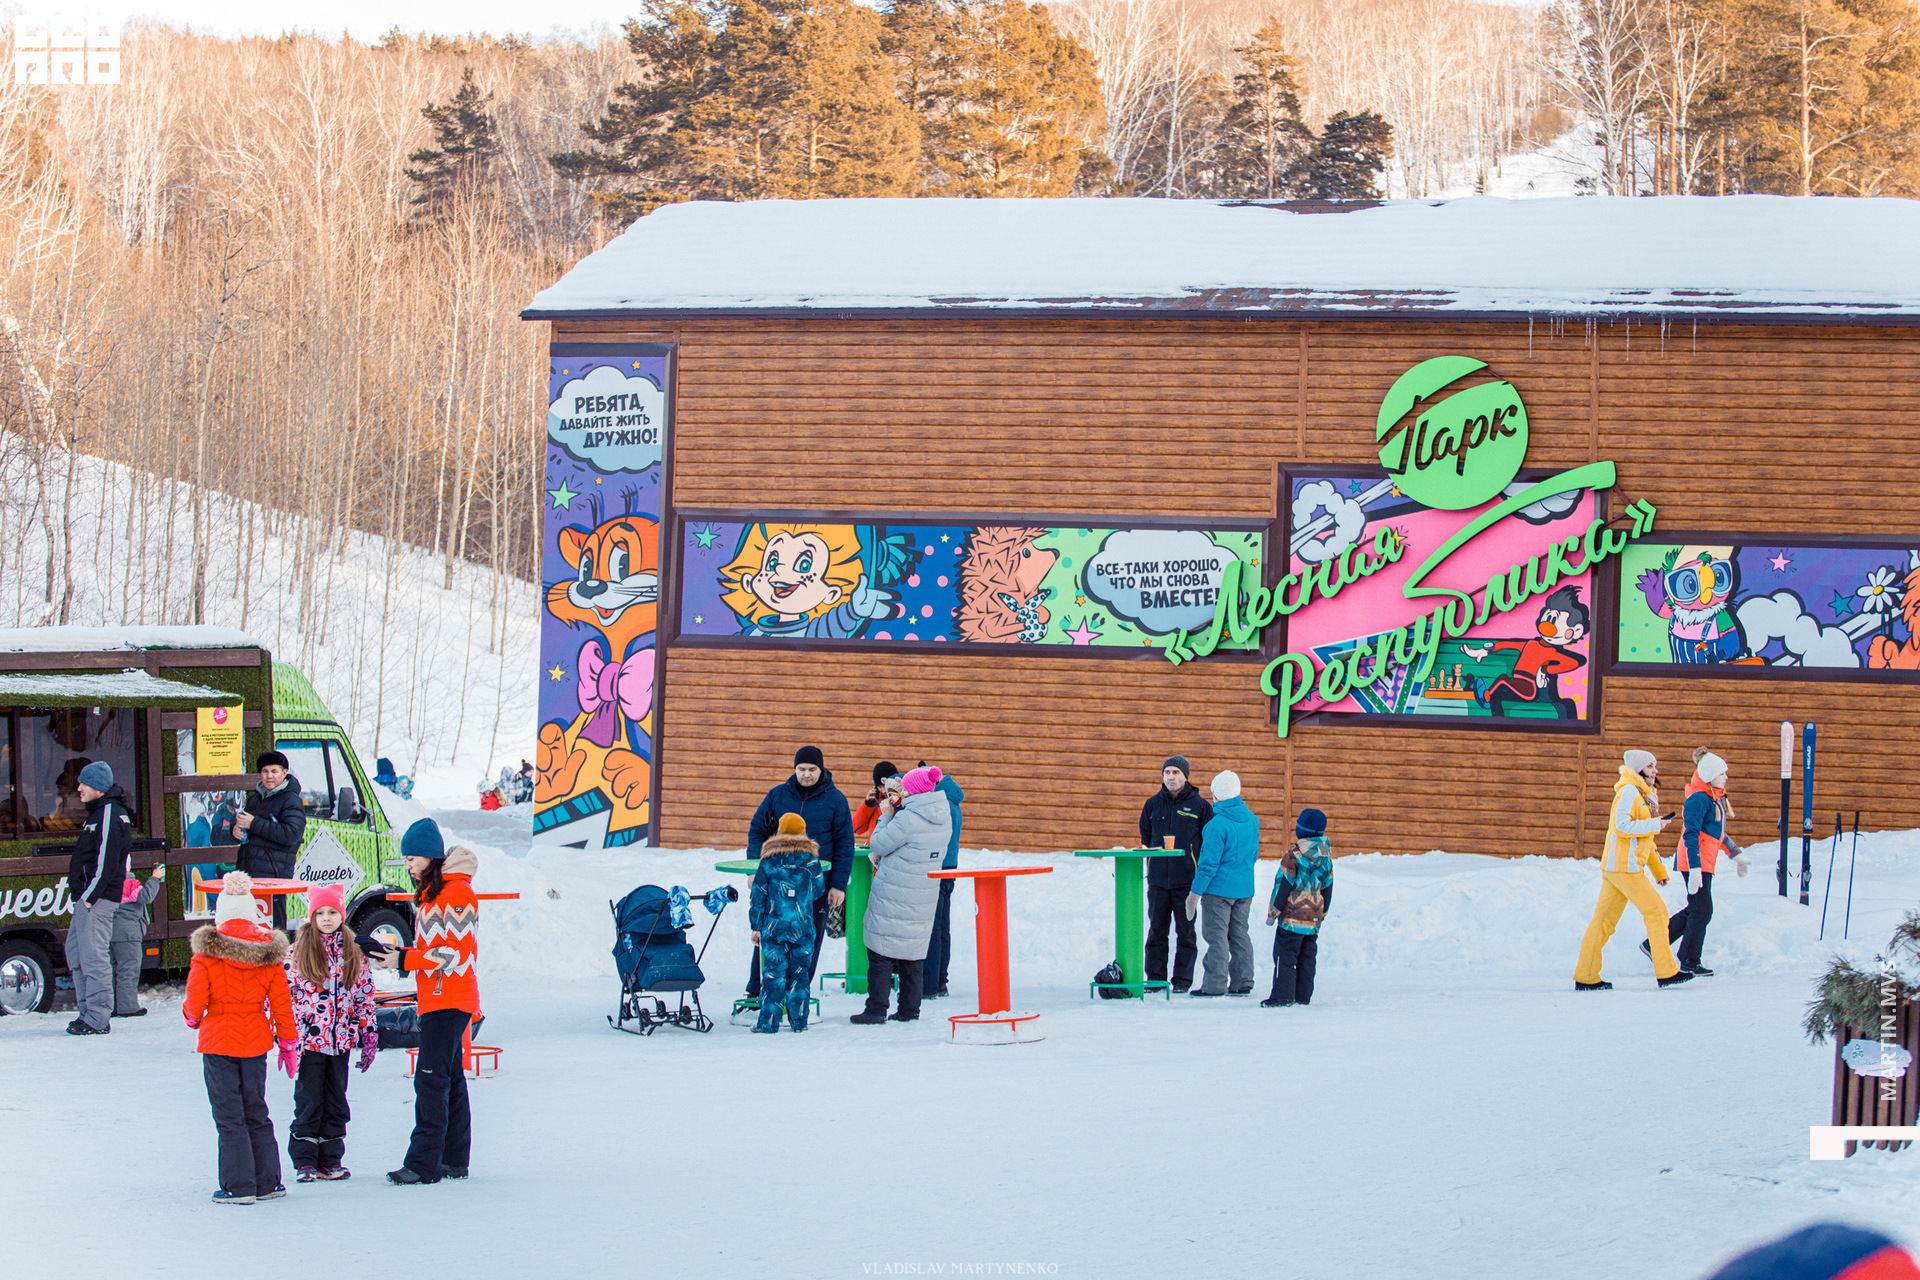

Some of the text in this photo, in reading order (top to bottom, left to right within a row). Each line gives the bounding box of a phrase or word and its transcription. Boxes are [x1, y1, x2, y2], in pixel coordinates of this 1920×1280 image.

[574, 393, 645, 414] РЕБЯТА,
[559, 414, 651, 431] ДАВАЙТЕ ЖИТЬ
[583, 428, 658, 449] ДРУЖНО!
[1380, 390, 1518, 477] Парк
[1096, 558, 1222, 577] ВСЕ-ТАКИ ХОРОШО,
[1110, 573, 1210, 590] ЧТО МЫ СНОВА
[300, 864, 354, 881] Sweeter
